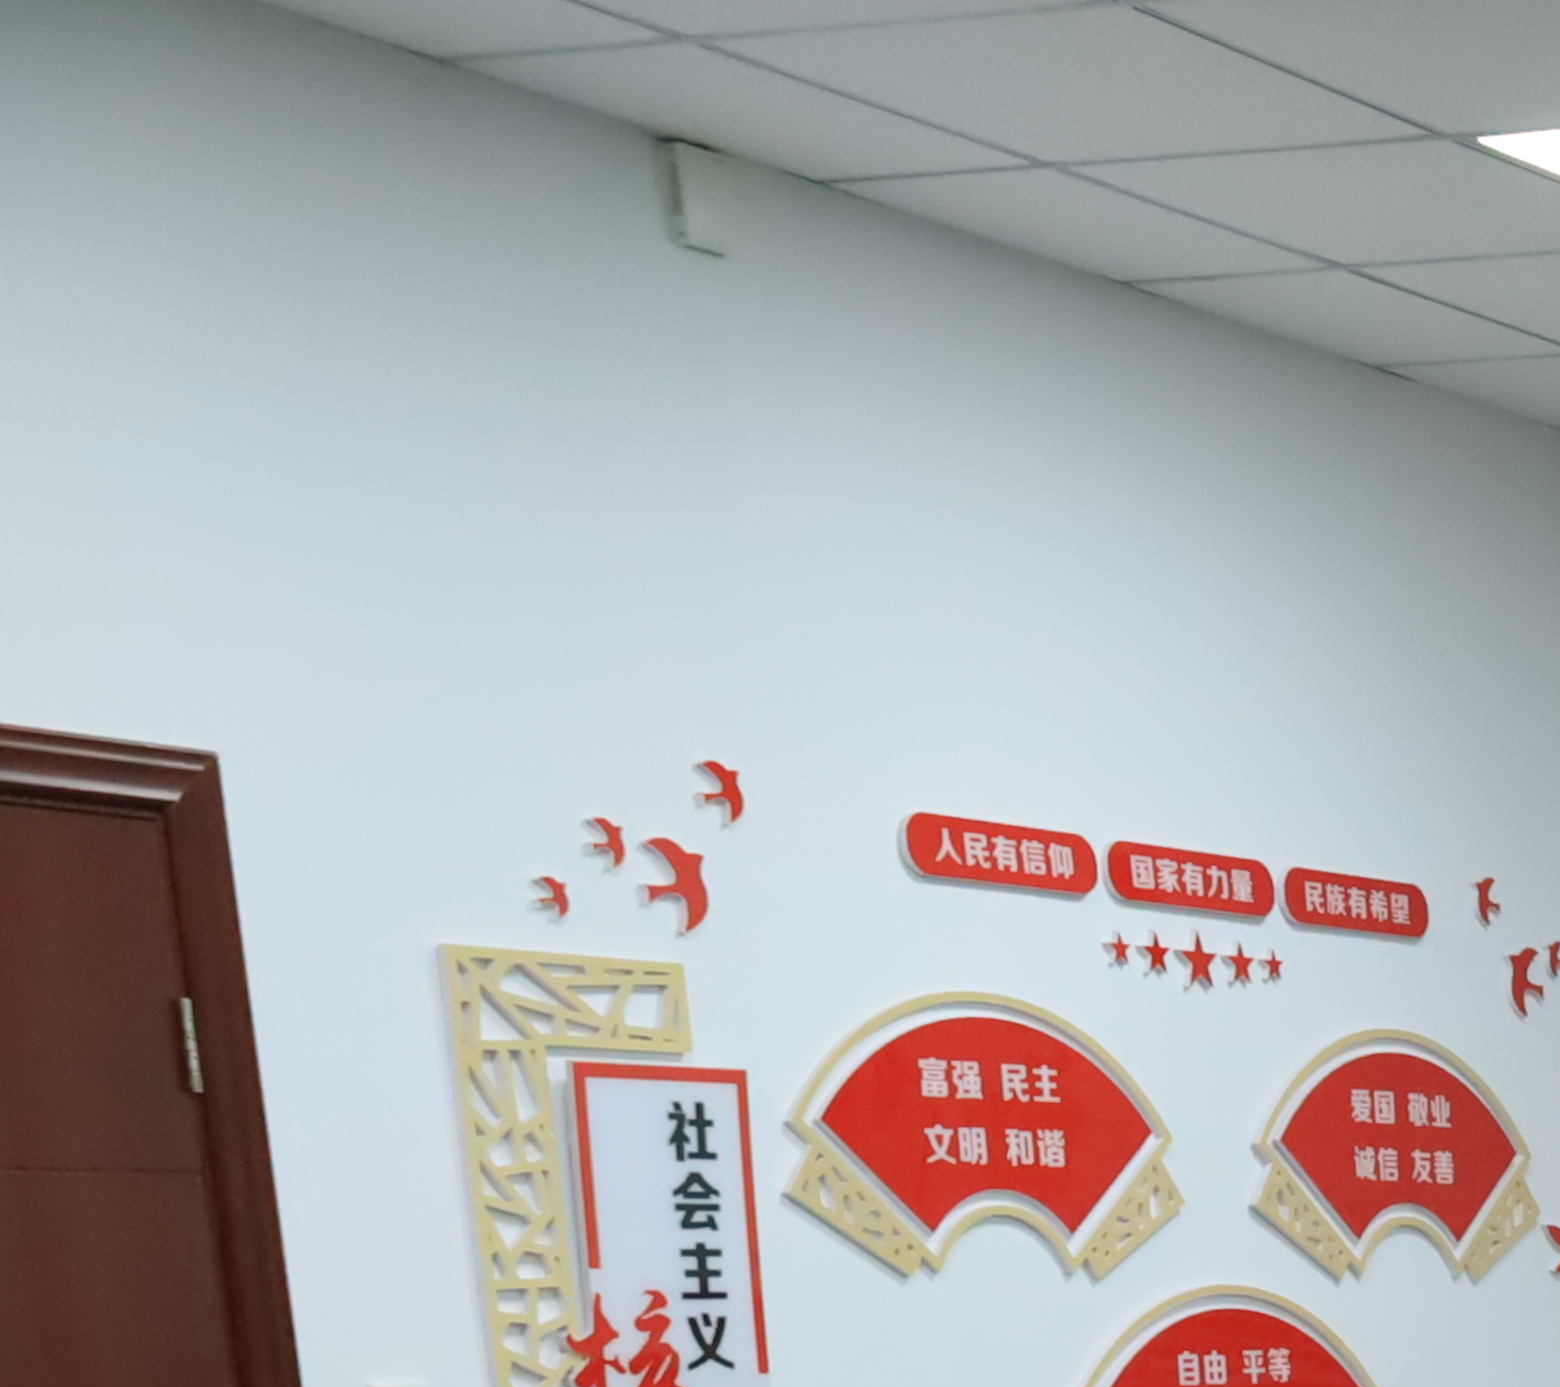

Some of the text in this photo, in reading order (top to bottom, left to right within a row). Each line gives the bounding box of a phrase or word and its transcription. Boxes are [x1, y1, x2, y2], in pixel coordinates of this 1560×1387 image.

[935, 827, 1075, 880] 人民有信仰
[1130, 854, 1255, 904] 国家有力量
[1304, 880, 1411, 925] 民族有希望
[918, 1057, 1061, 1104] 富强 民主
[1350, 1089, 1452, 1129] 爱国 敬业
[924, 1123, 1066, 1168] 文明 和谐
[1354, 1146, 1455, 1185] 诚信 友善
[668, 1101, 735, 1371] 社会主义
[1177, 1347, 1292, 1386] 自由 平等
